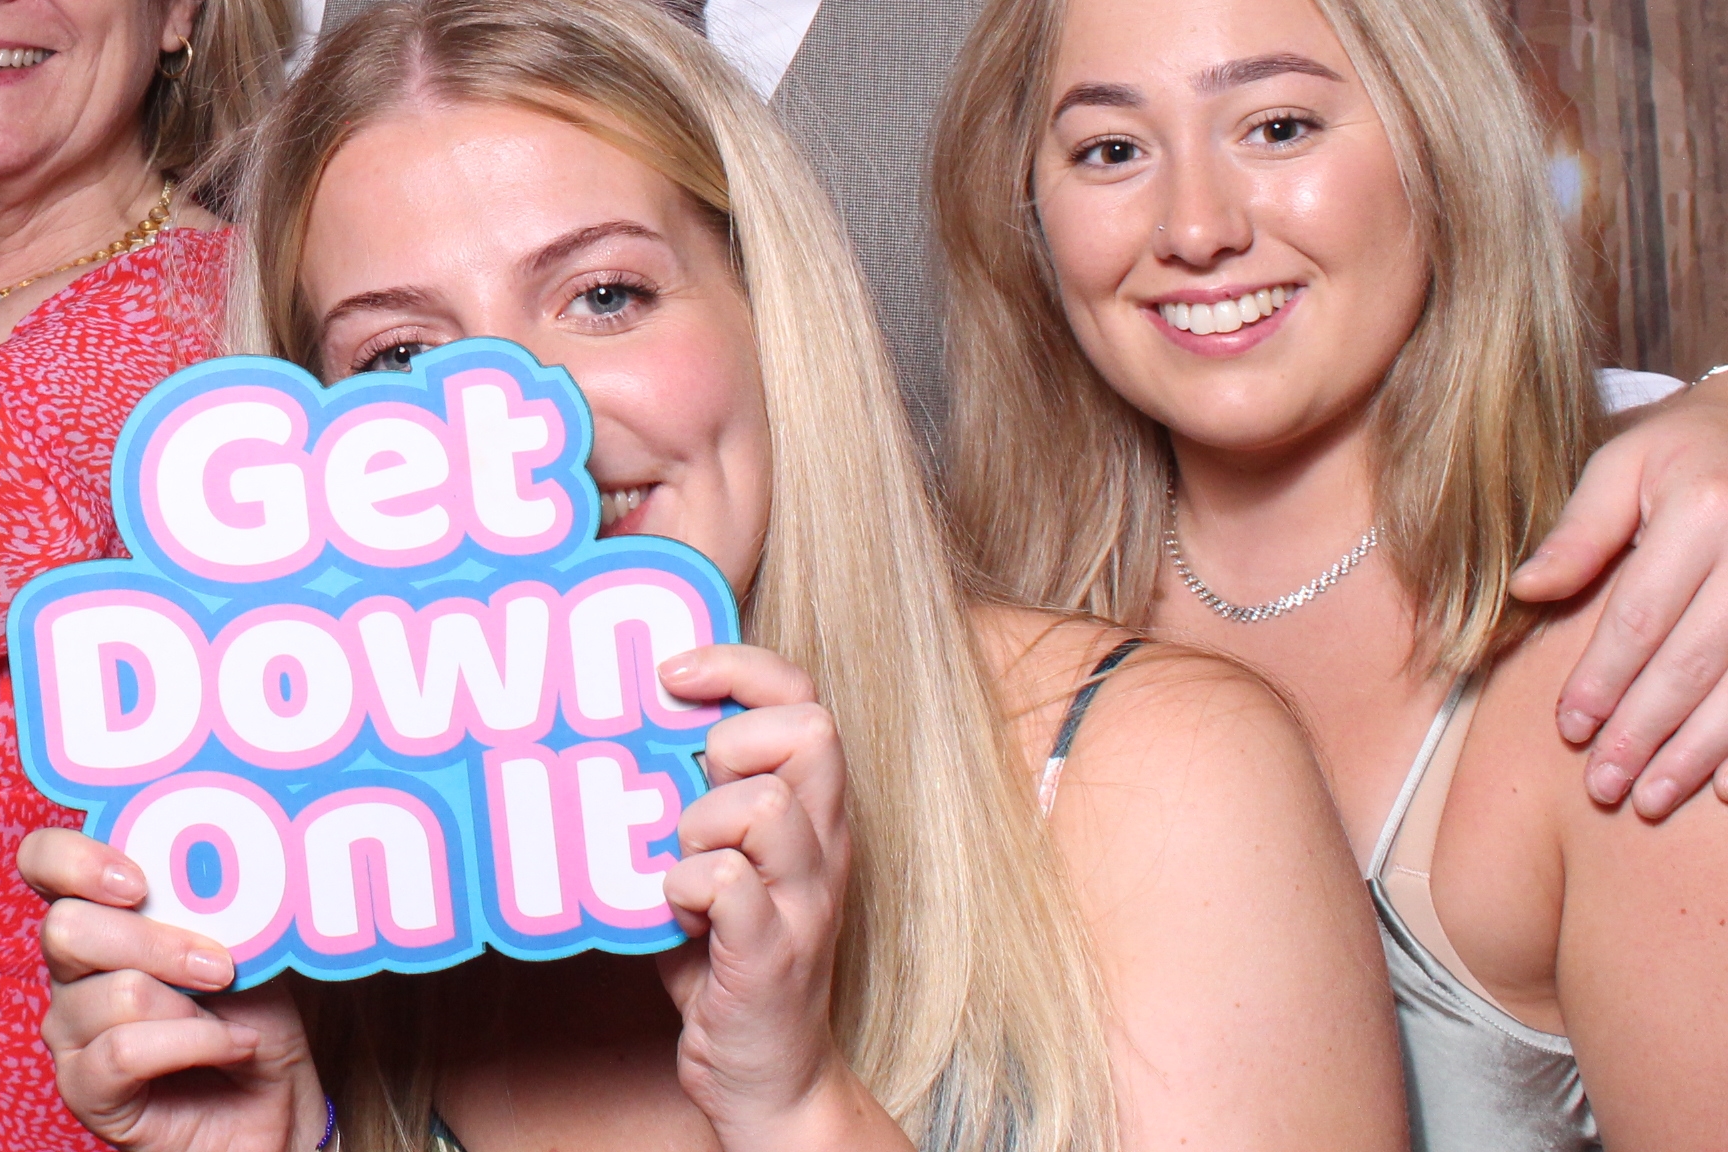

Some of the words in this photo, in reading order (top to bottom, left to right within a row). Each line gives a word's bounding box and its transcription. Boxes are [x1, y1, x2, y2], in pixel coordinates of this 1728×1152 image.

[154, 382, 558, 567] Get
[50, 583, 705, 769] Down
[123, 785, 439, 949] On
[503, 756, 669, 919] It
